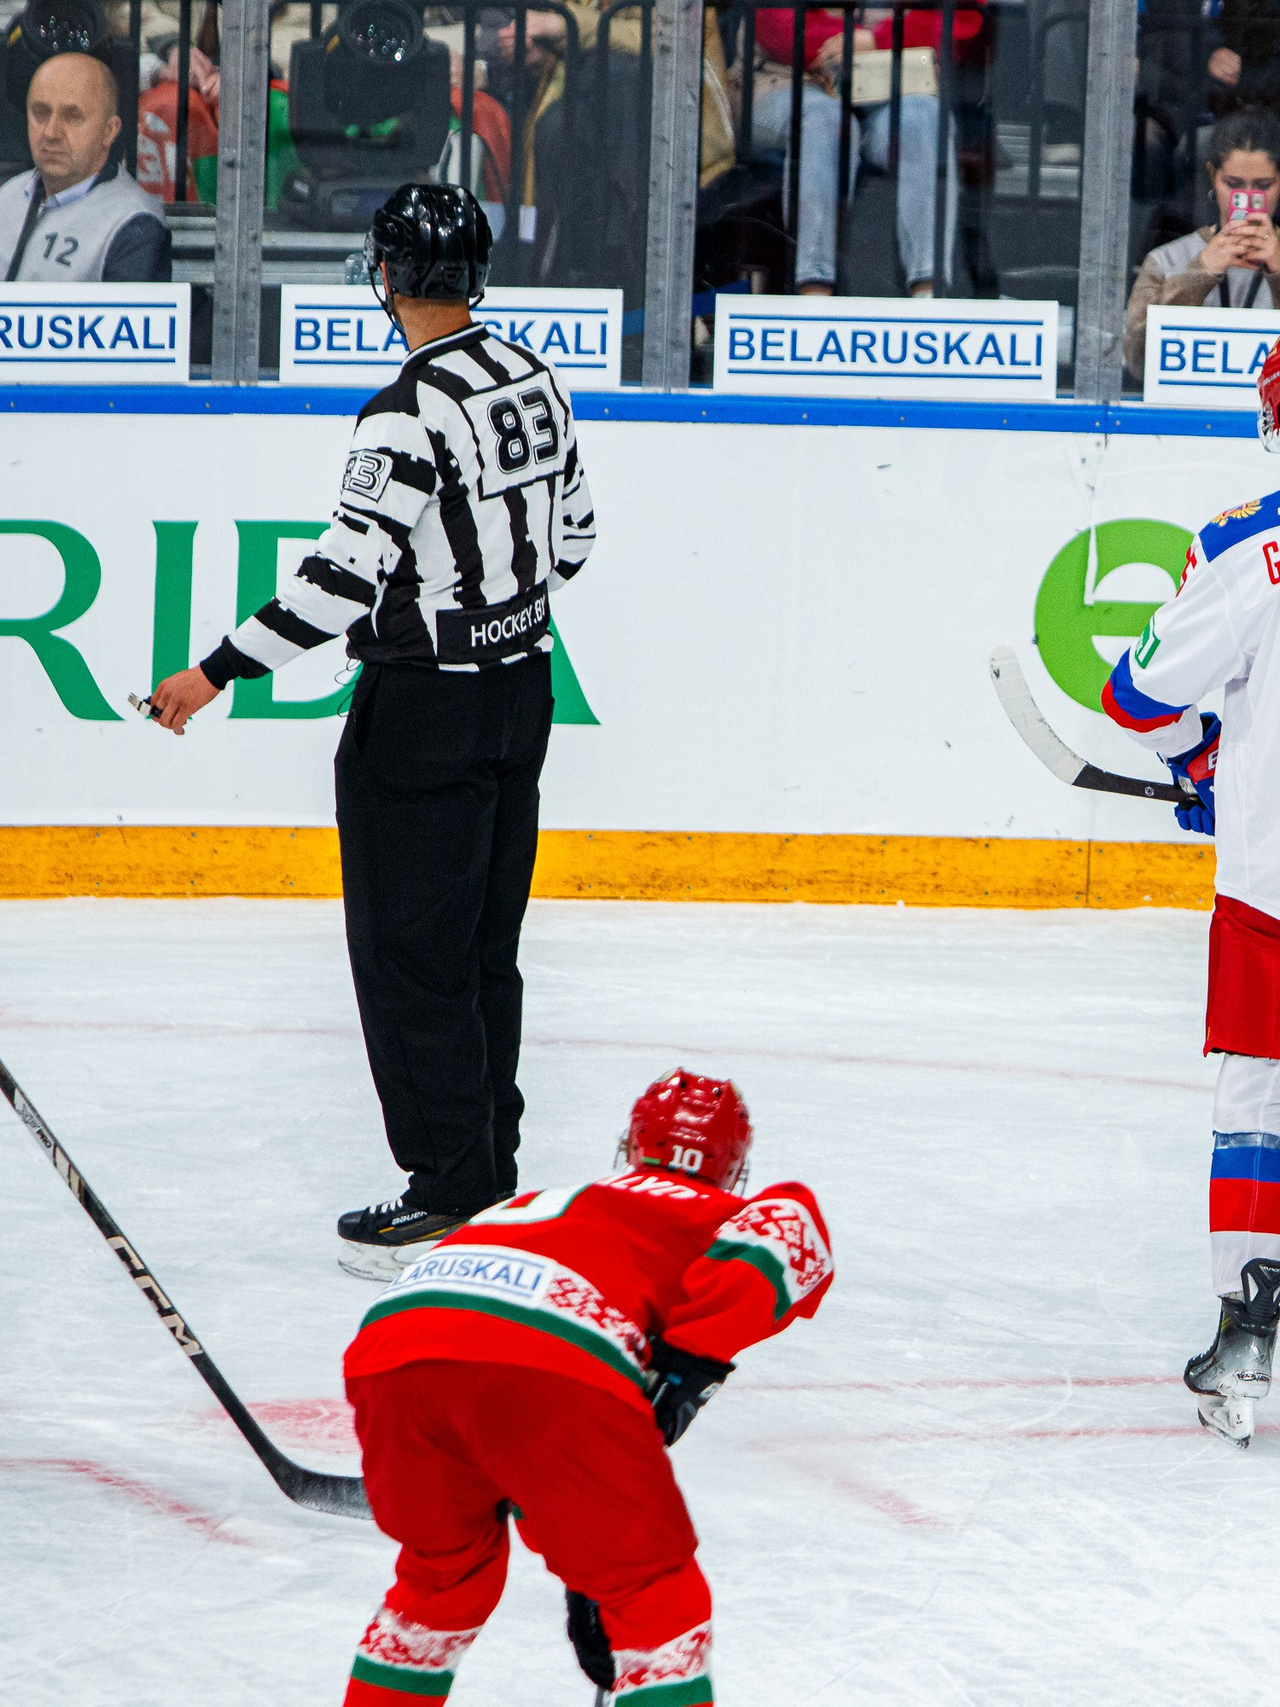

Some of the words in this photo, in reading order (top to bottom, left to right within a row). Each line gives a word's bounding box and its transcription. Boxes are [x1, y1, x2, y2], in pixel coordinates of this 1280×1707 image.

[43, 231, 79, 267] 12
[294, 317, 607, 355] BELASKALI
[728, 327, 1042, 367] BELARUSKALI
[487, 386, 560, 475] 83
[470, 594, 546, 648] HOCKEY.BY
[36, 1128, 52, 1149] PRO
[669, 1144, 703, 1174] 10
[106, 1234, 204, 1357] CCM
